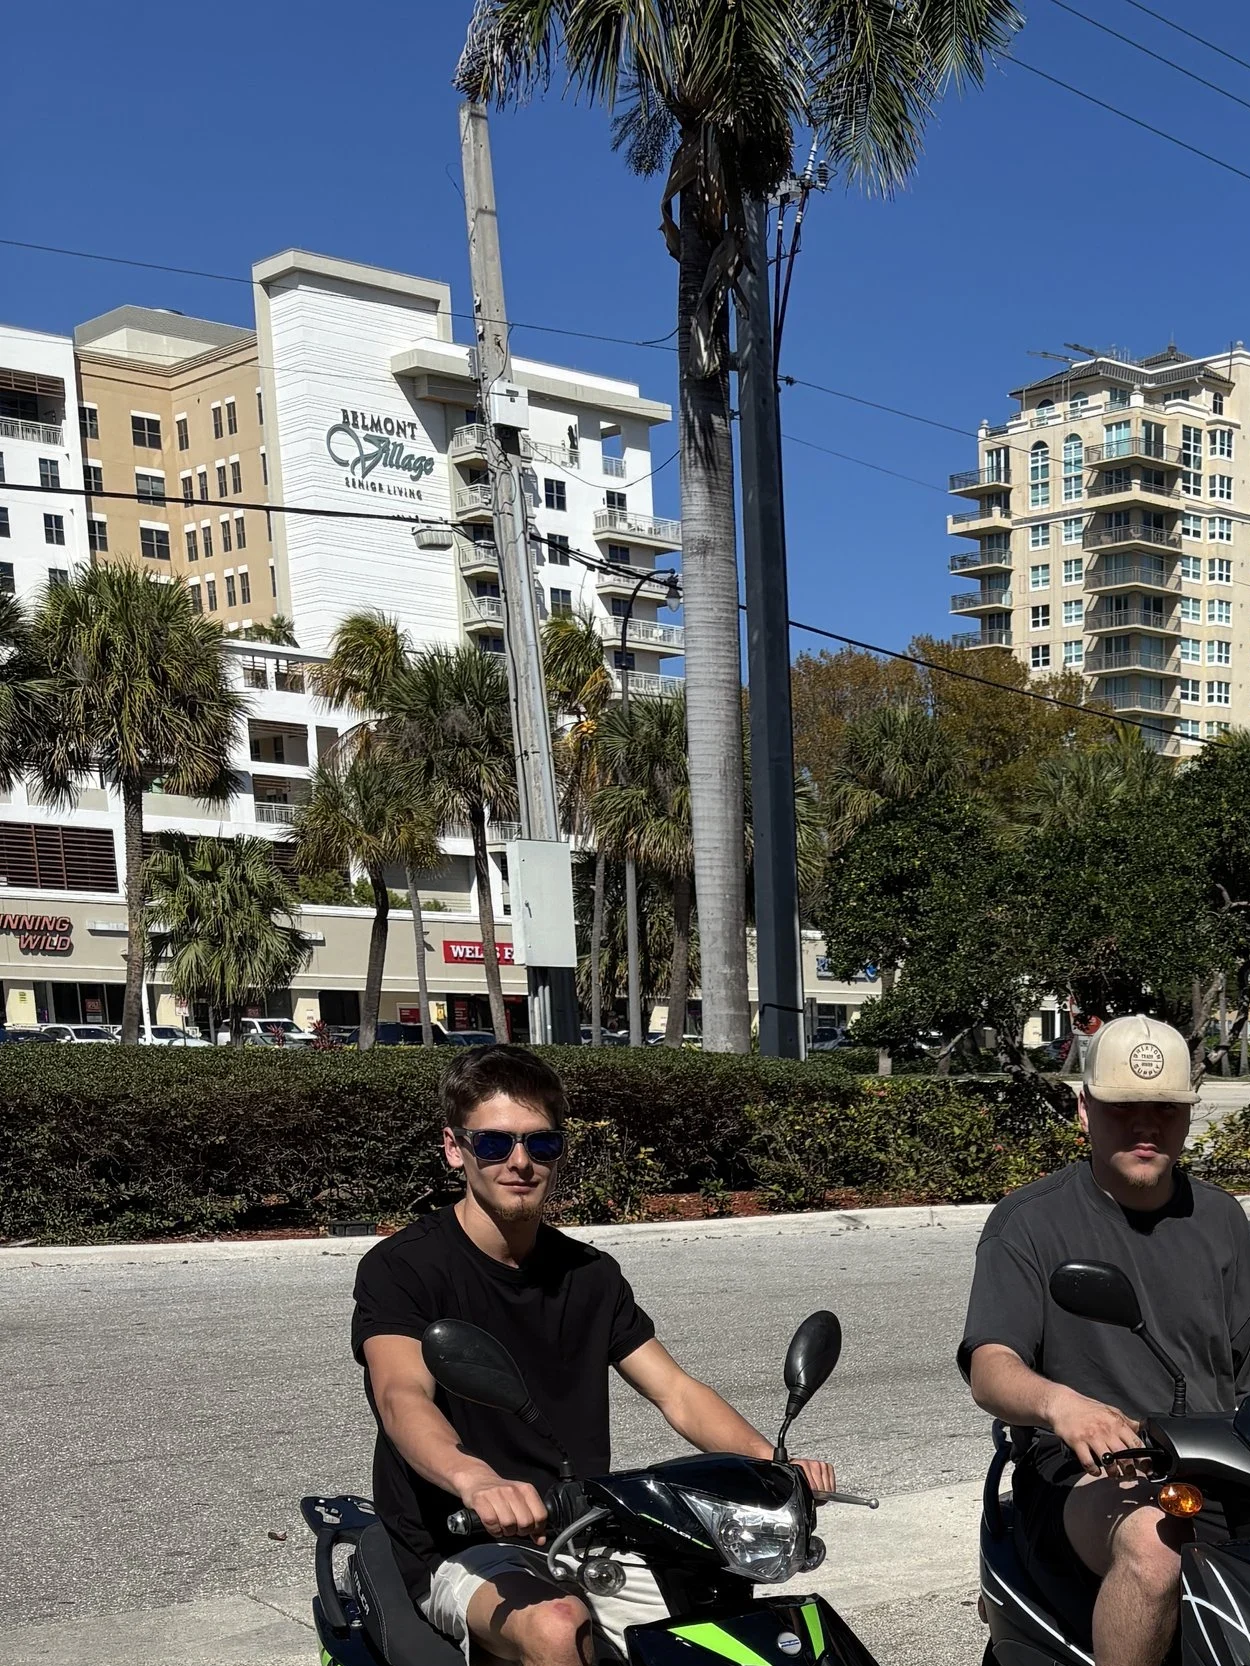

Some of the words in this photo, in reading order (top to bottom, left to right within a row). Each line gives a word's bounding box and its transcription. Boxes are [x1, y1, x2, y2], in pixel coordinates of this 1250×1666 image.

[341, 408, 418, 441] BELMONT
[326, 423, 436, 482] Village
[345, 477, 384, 494] SENIOR
[387, 484, 423, 501] LIVING
[19, 934, 72, 951] WILD
